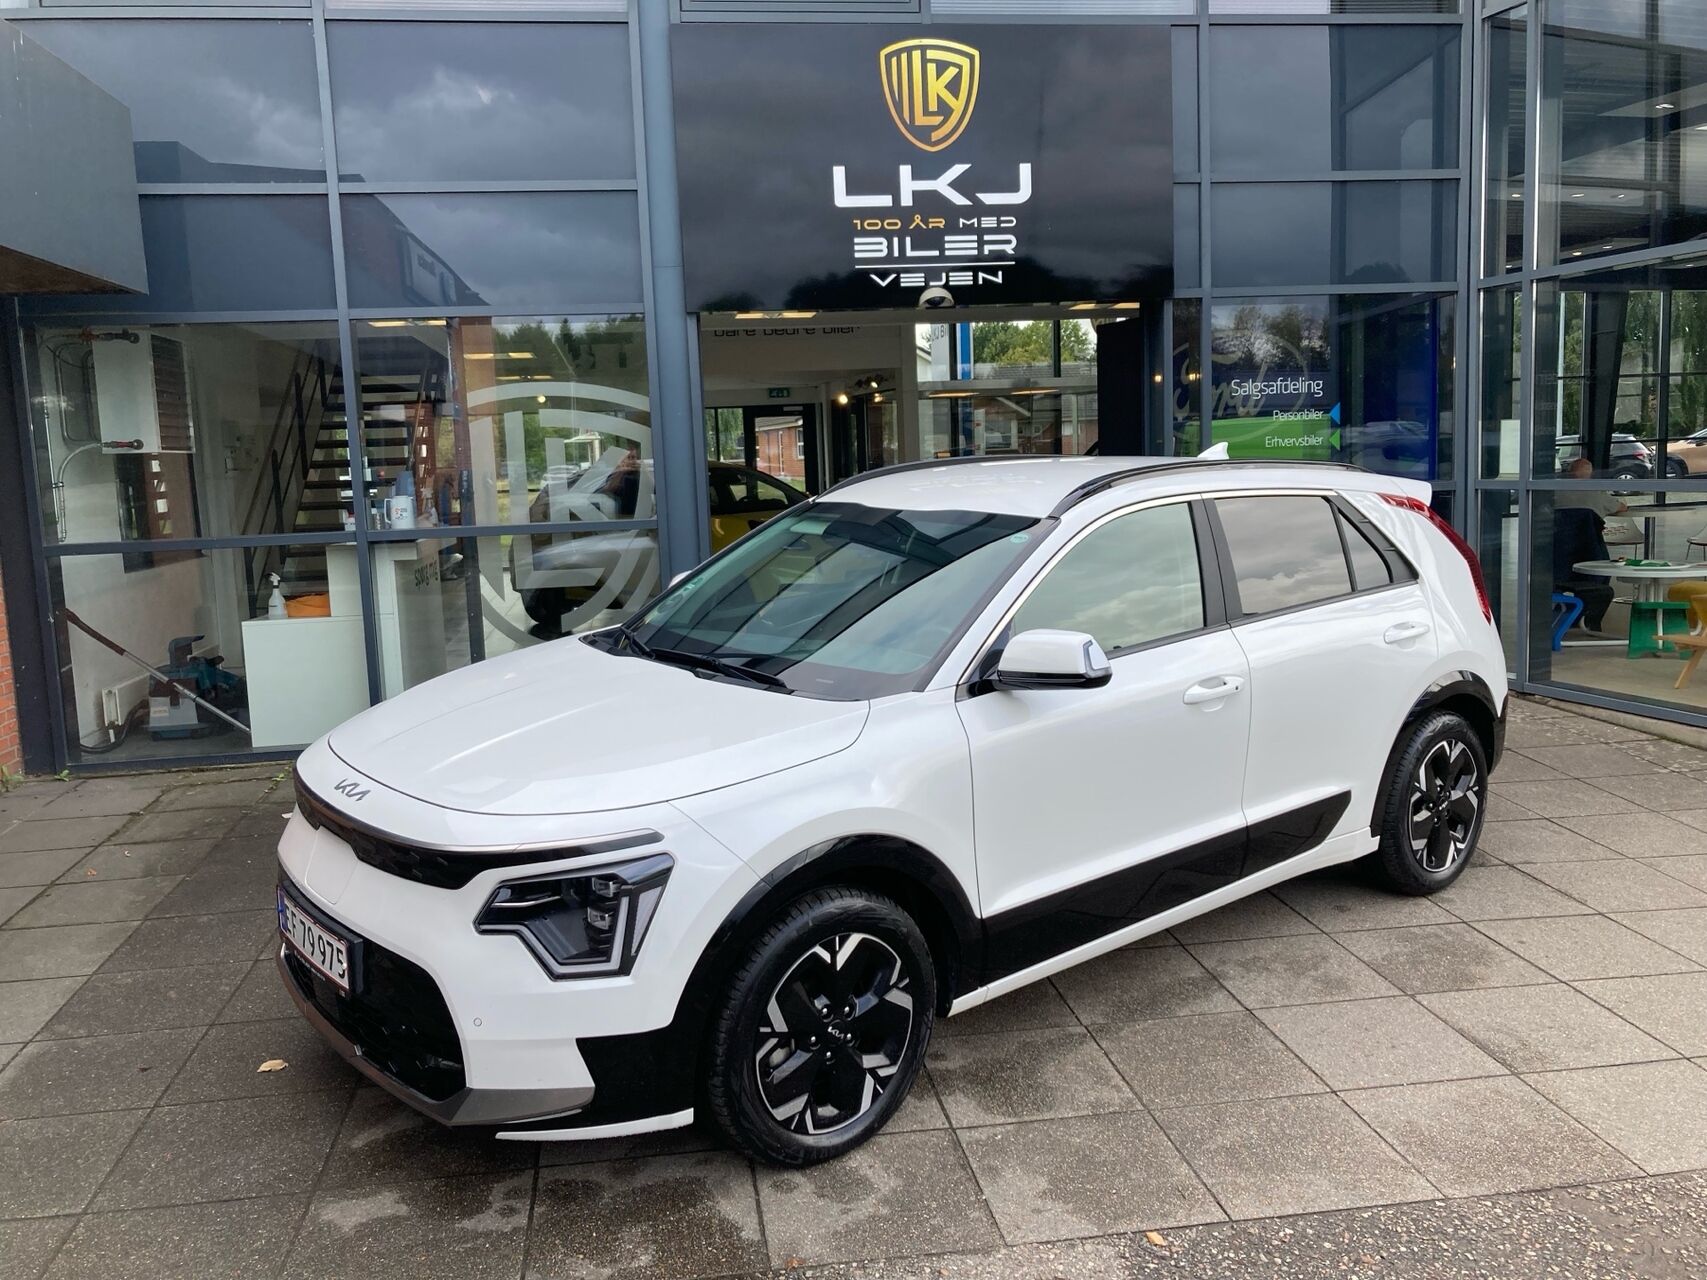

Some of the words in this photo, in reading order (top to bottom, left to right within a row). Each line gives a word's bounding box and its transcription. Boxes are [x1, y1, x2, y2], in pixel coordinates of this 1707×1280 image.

[833, 163, 1032, 208] LKJ
[853, 219, 901, 230] 100
[909, 214, 945, 229] ÅR
[959, 216, 1016, 228] MED
[854, 234, 1017, 258] BILER
[870, 271, 1003, 287] VEJEN
[1231, 377, 1324, 400] Salgsafdeling
[1273, 409, 1324, 421] Personbiler
[1265, 435, 1324, 448] Erhvervsbiler
[299, 918, 315, 957] 79
[318, 934, 347, 979] 975
